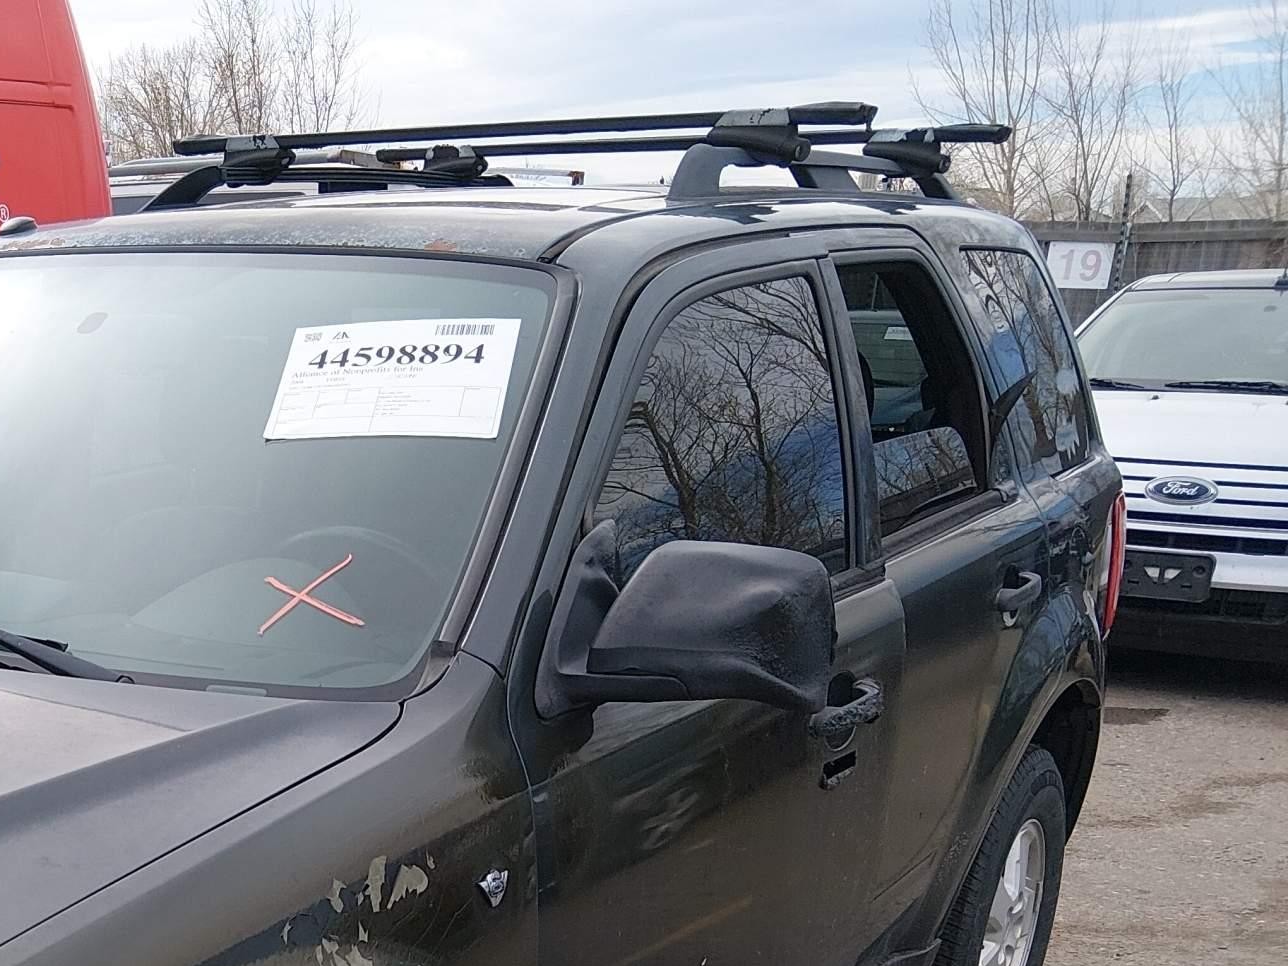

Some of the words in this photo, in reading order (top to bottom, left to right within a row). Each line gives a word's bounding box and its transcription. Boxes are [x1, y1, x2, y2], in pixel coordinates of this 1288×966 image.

[1060, 249, 1102, 282] 19
[307, 343, 486, 369] 44598894
[1162, 481, 1200, 496] Ford
